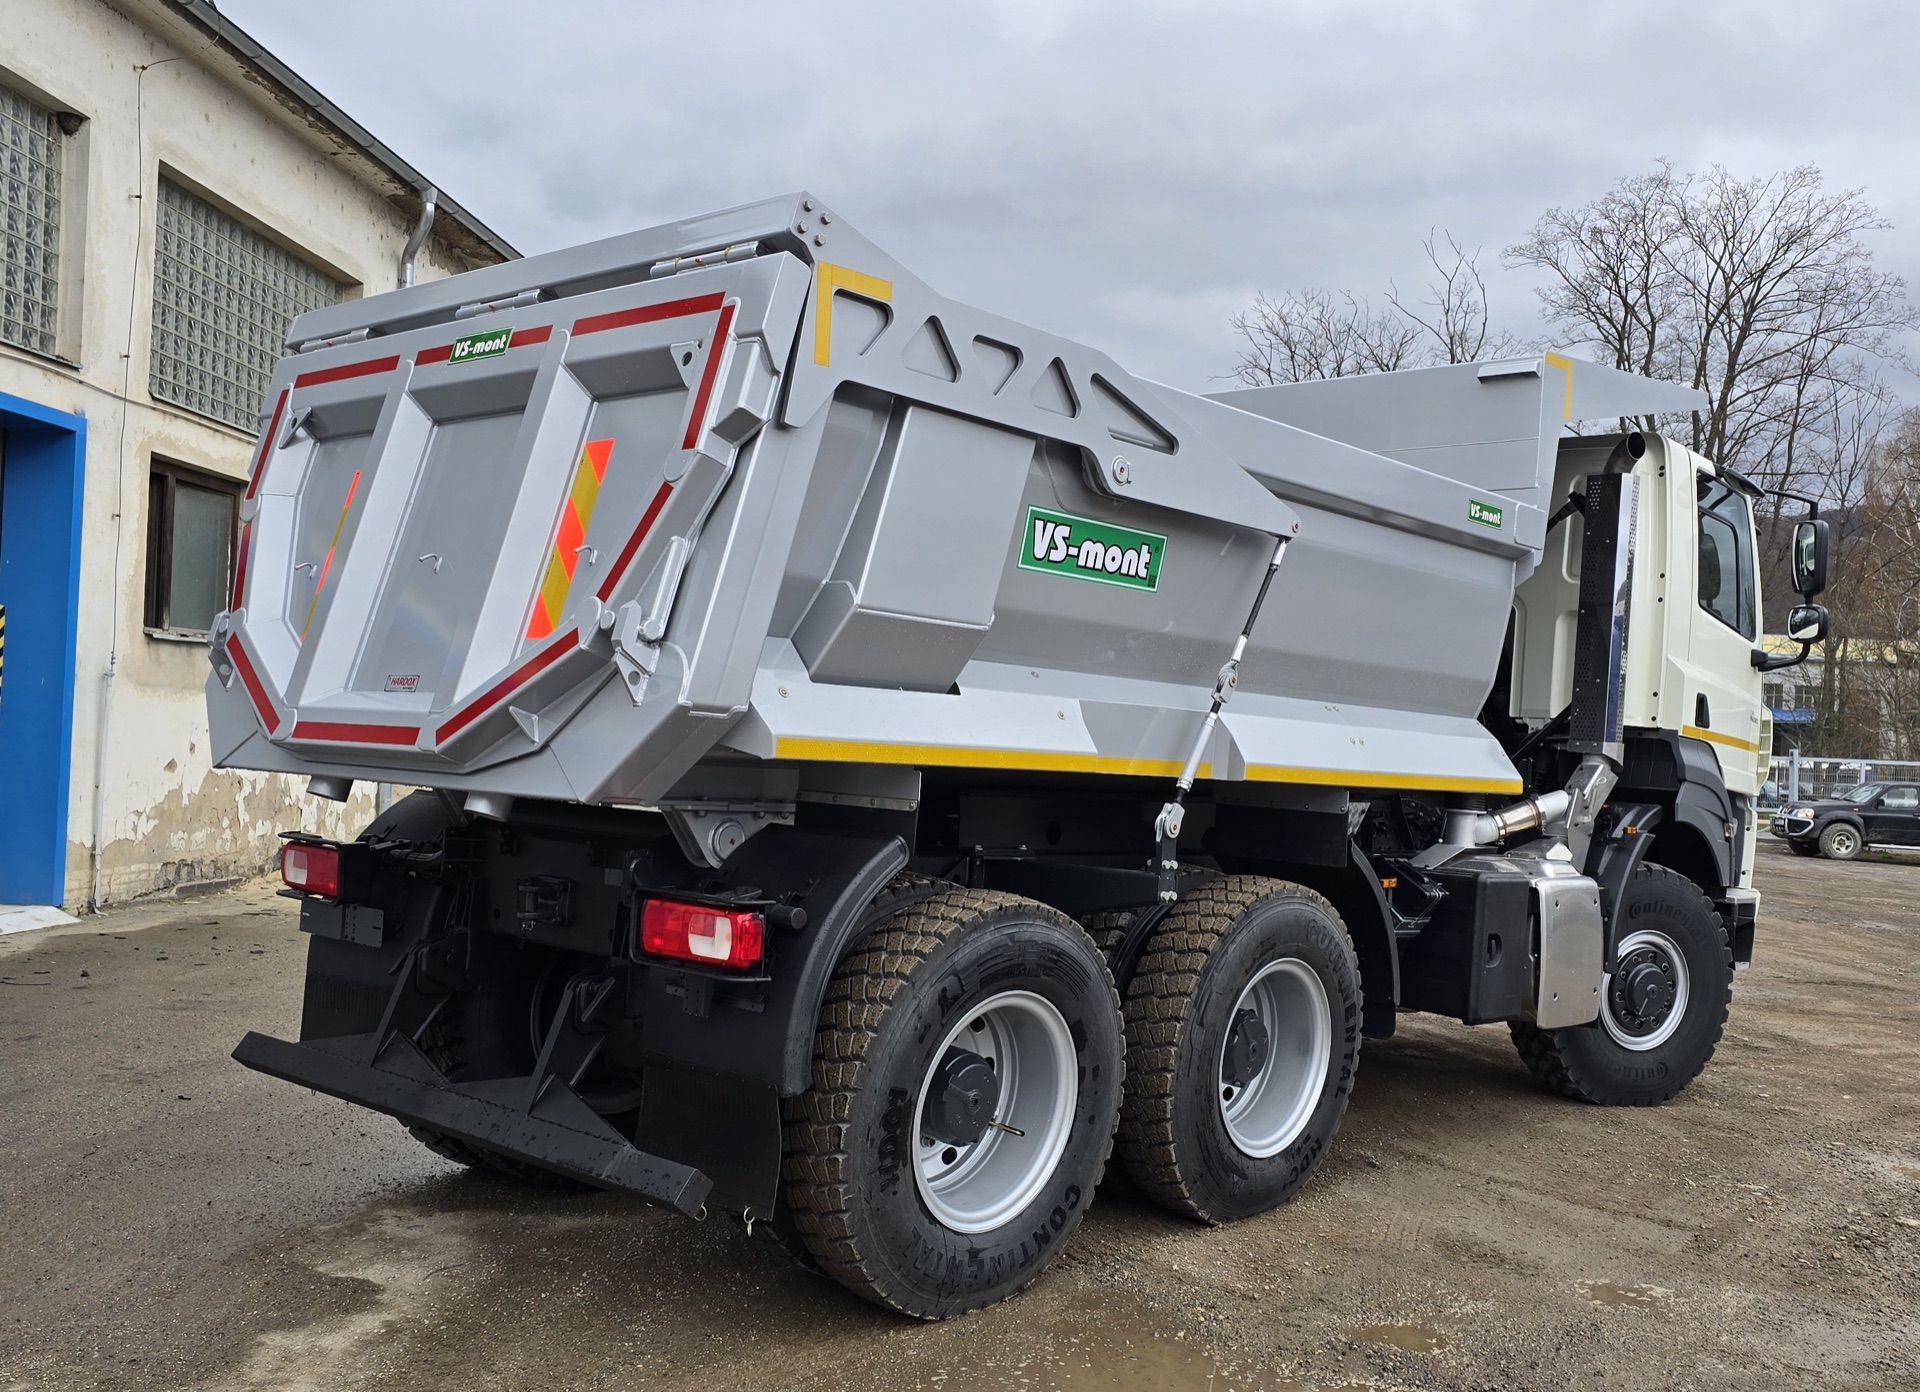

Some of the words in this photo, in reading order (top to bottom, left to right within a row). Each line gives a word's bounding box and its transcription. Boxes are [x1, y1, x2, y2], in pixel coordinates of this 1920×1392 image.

[455, 334, 507, 358] VS-mont
[1470, 503, 1502, 525] VS-mont
[1033, 518, 1152, 580] VS-mont
[390, 677, 417, 686] HARDOX
[1307, 918, 1357, 1099] CONTINENTAL
[902, 1184, 1082, 1292] CONTINENTAL
